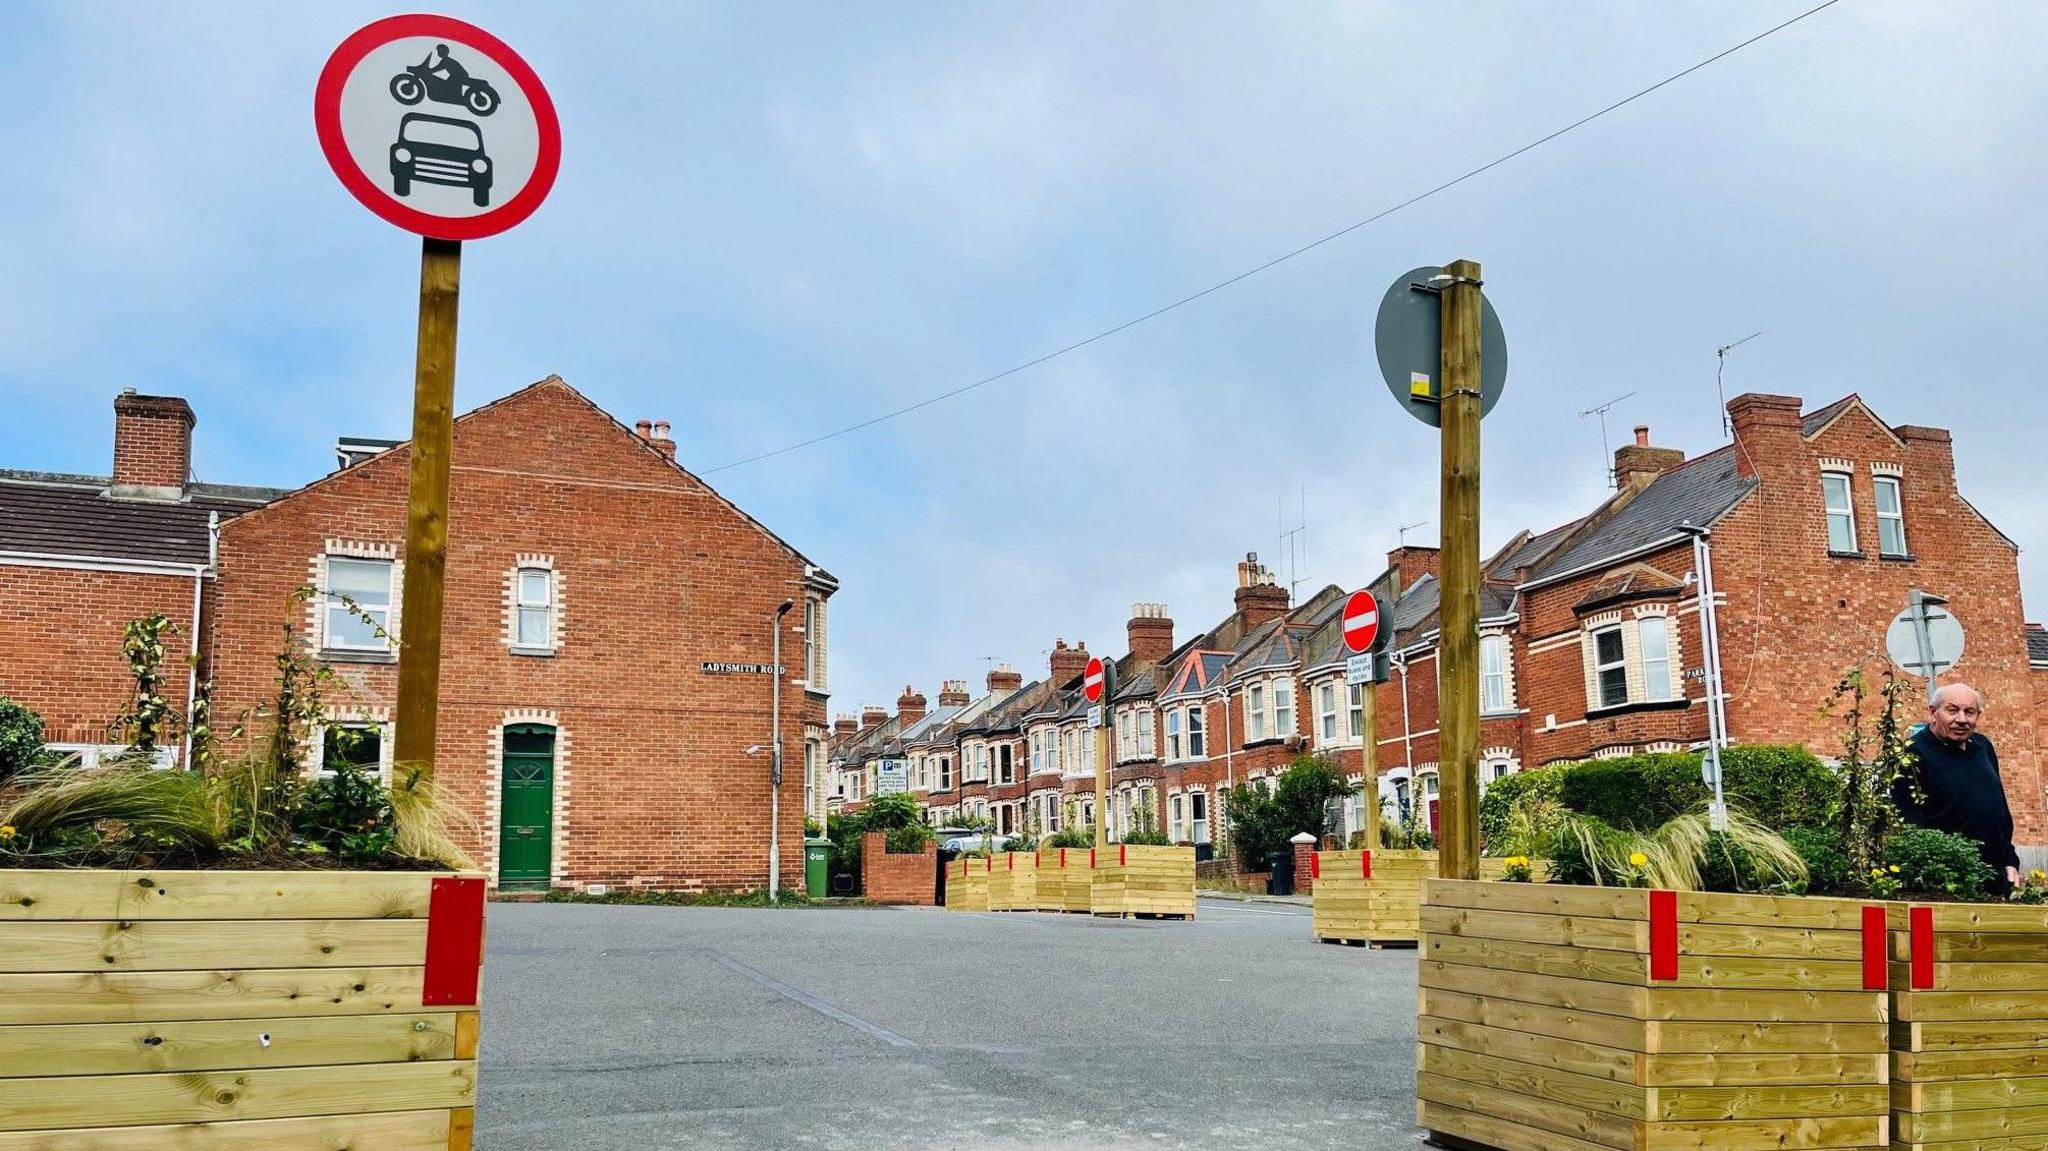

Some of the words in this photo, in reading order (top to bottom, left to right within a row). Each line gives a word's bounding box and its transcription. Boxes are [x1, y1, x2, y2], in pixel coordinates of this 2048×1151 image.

[700, 662, 757, 674] LADYSMITH
[760, 665, 786, 675] ROD
[1686, 668, 1705, 678] PARK
